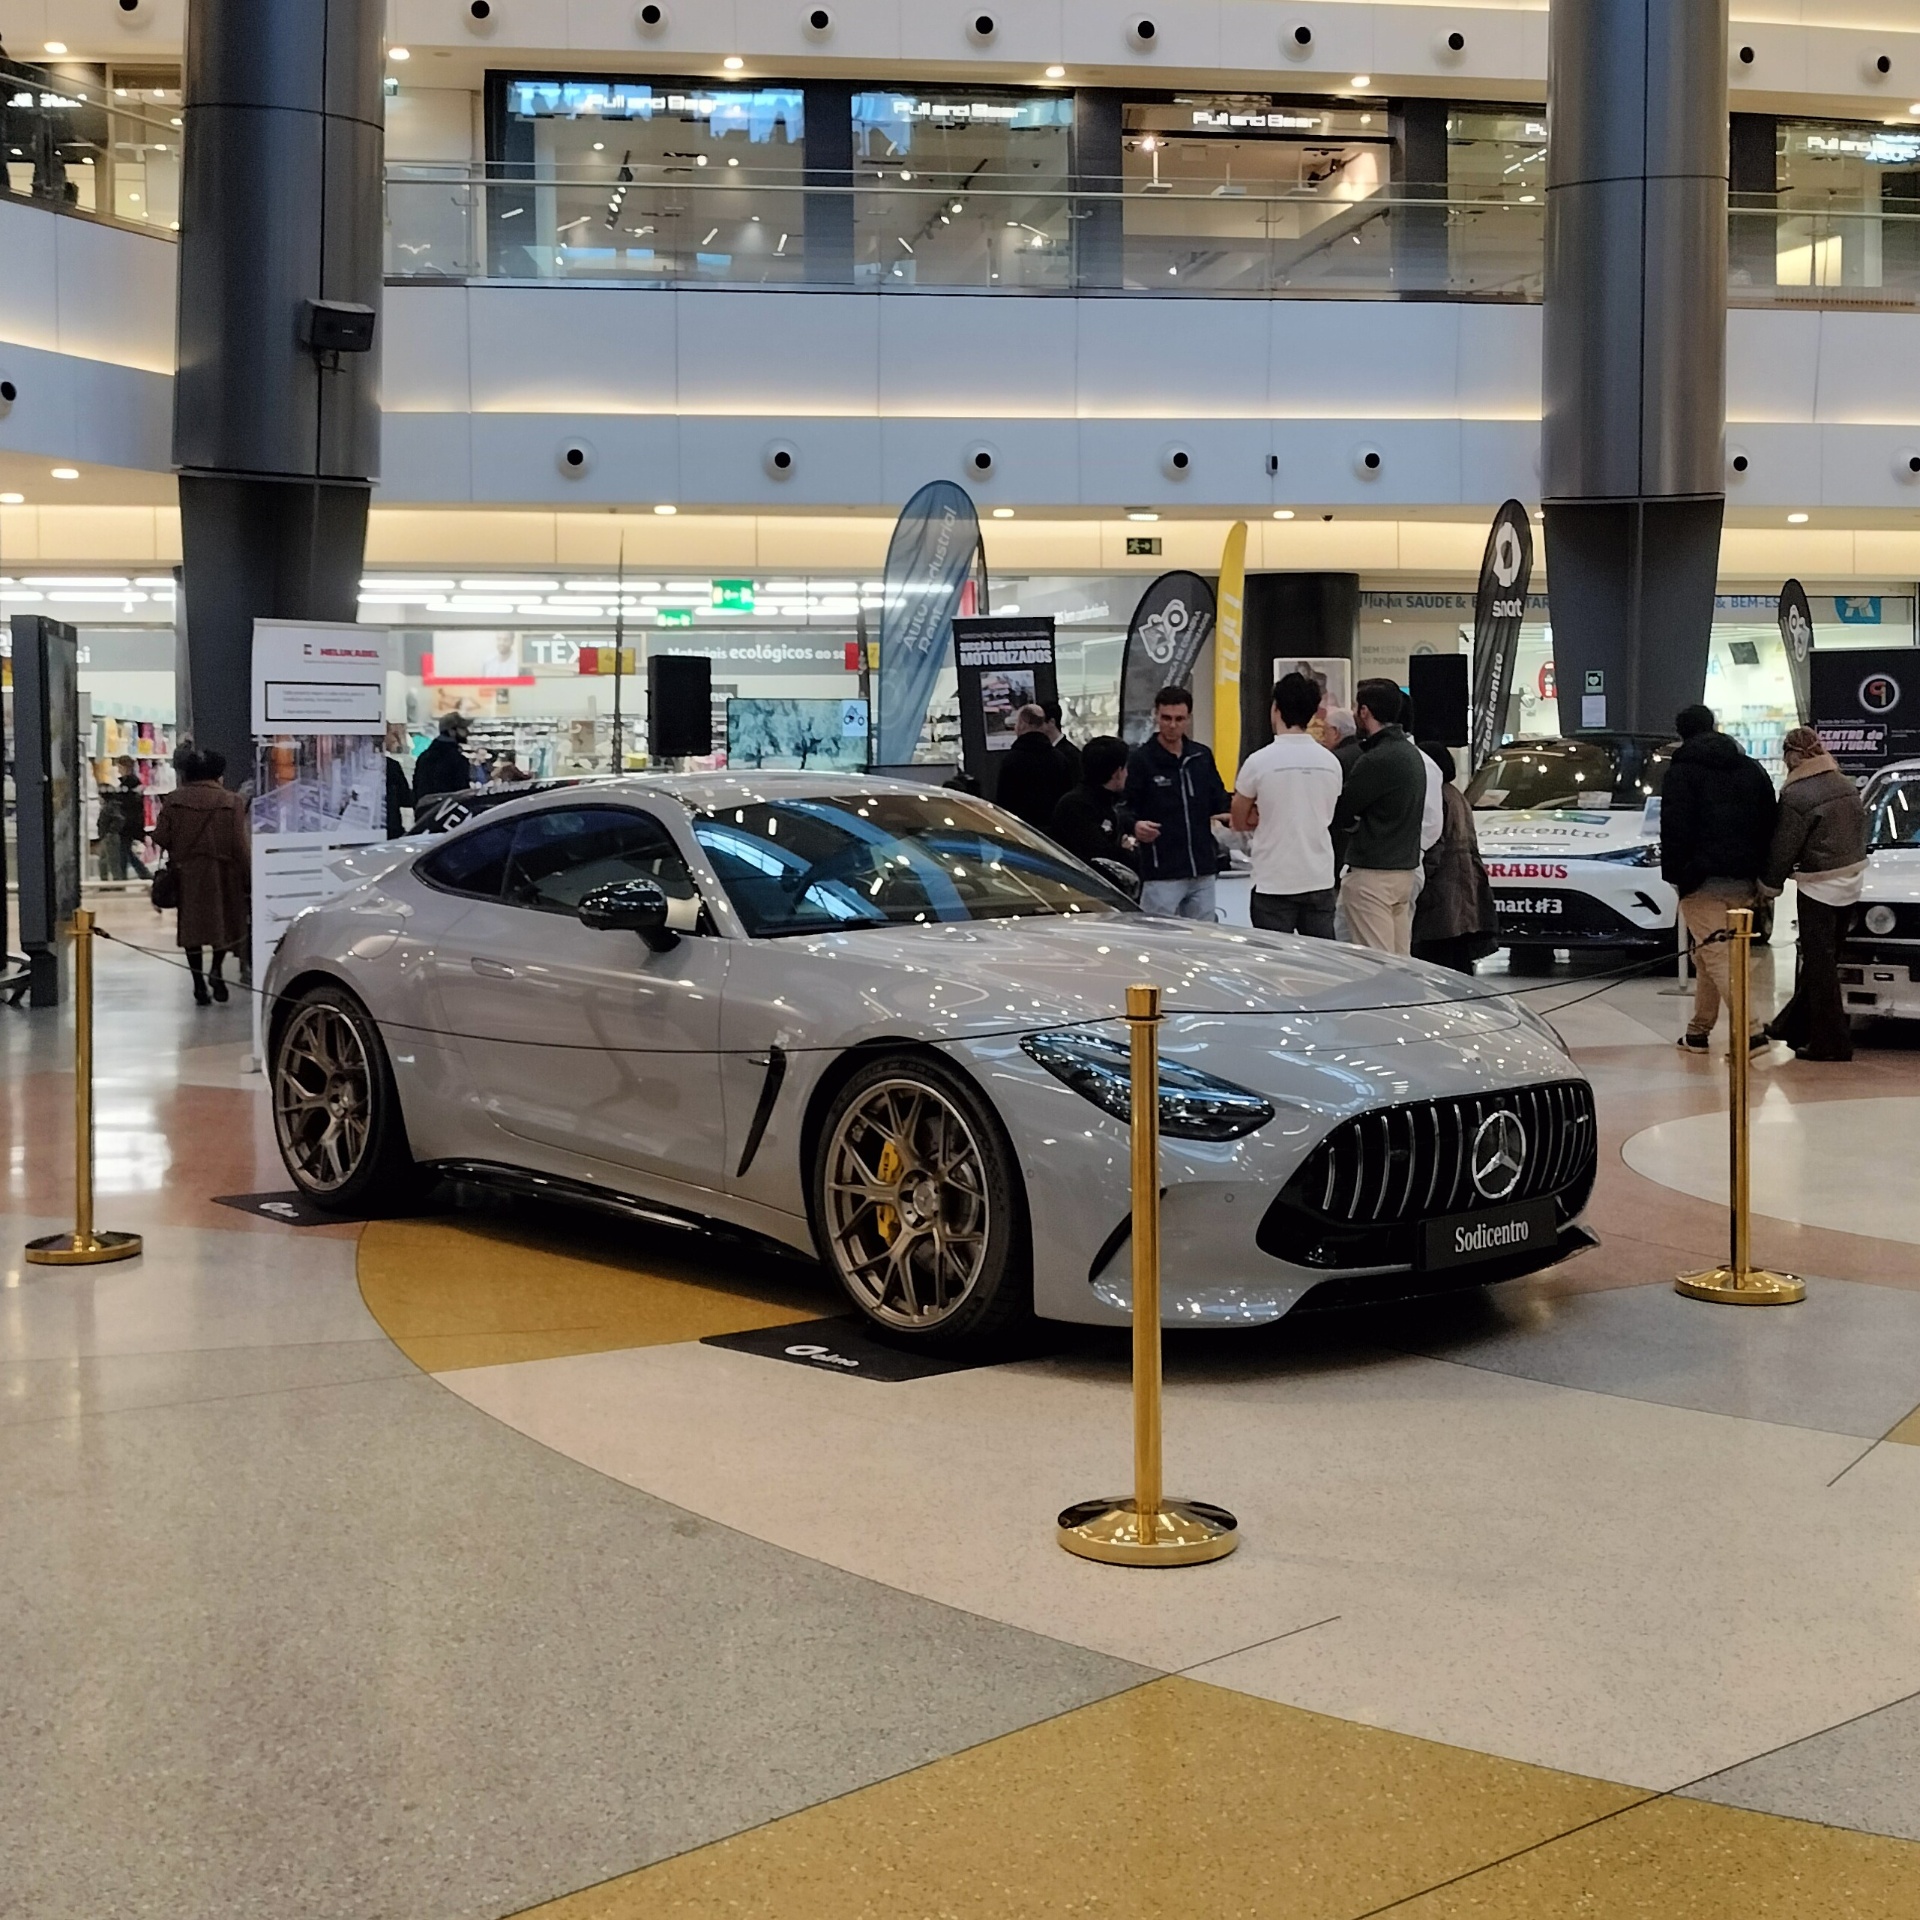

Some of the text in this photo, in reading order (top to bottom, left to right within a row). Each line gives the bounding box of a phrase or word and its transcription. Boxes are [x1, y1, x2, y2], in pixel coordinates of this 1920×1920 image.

[1192, 111, 1321, 129] Pull and Bear
[1731, 597, 1780, 609] BEM-ES
[729, 644, 813, 663] ecológicos
[960, 650, 1052, 666] MOTORIZADOS
[1478, 825, 1610, 839] odicentro
[1455, 1219, 1529, 1253] Sodicentro
